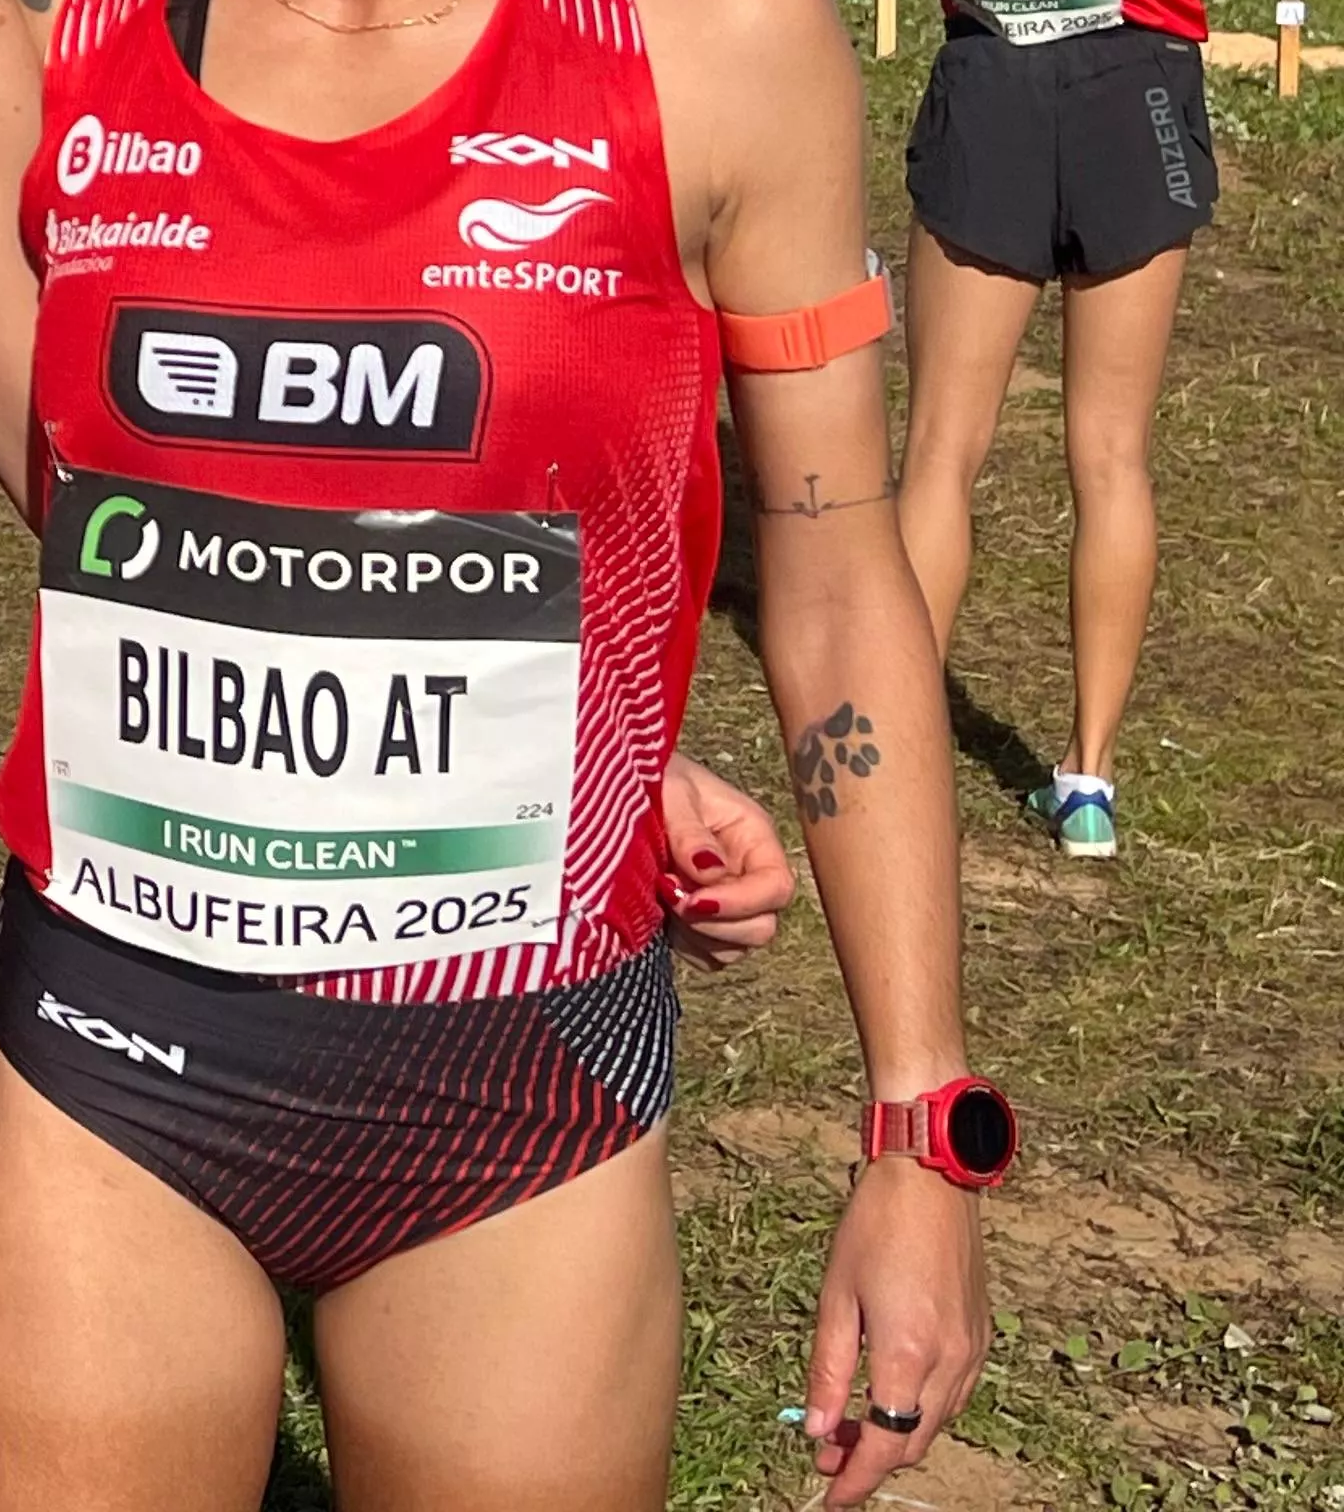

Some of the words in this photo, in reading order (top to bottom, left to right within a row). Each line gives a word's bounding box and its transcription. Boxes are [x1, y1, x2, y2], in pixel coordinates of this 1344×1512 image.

[57, 114, 203, 196] Bilbao
[1145, 87, 1197, 209] ADIZERO
[56, 211, 212, 256] Bizkaialde
[422, 259, 623, 297] emteSPORT
[256, 341, 444, 428] BM
[178, 529, 541, 594] MOTORPOR
[118, 636, 349, 778] BILBAO
[374, 672, 468, 776] AT
[163, 819, 173, 850] I
[179, 823, 257, 867] RUN
[515, 801, 554, 820] 224
[70, 857, 378, 947] ALBUFEIRA
[394, 884, 532, 941] 2025
